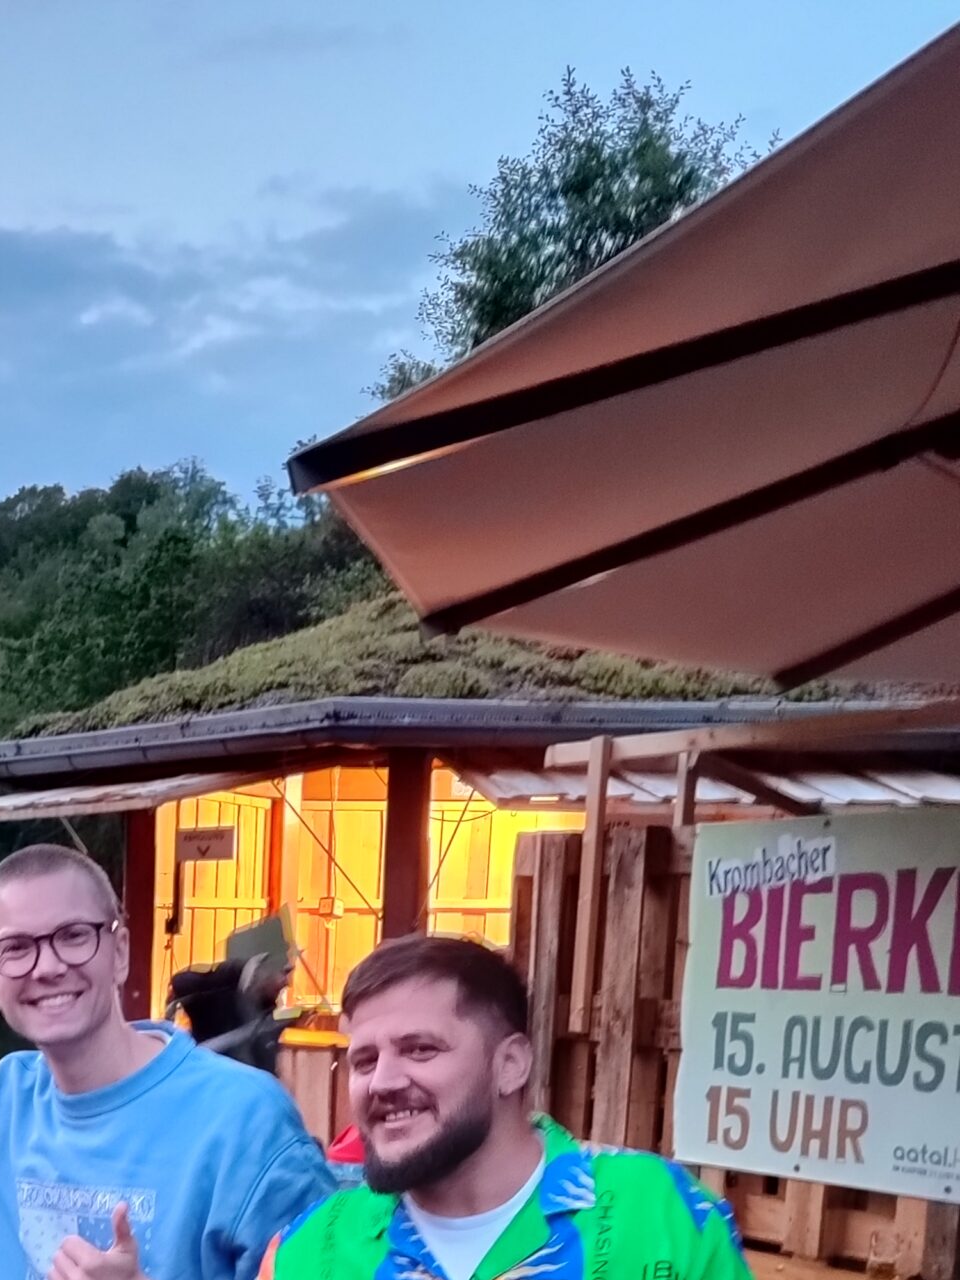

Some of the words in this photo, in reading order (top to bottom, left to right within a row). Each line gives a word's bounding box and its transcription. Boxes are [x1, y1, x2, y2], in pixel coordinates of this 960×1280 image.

[708, 843, 832, 897] Krombacher
[715, 866, 960, 997] BIERK
[711, 1011, 765, 1077] 15.
[705, 1085, 750, 1151] 15
[769, 1090, 869, 1165] UHR
